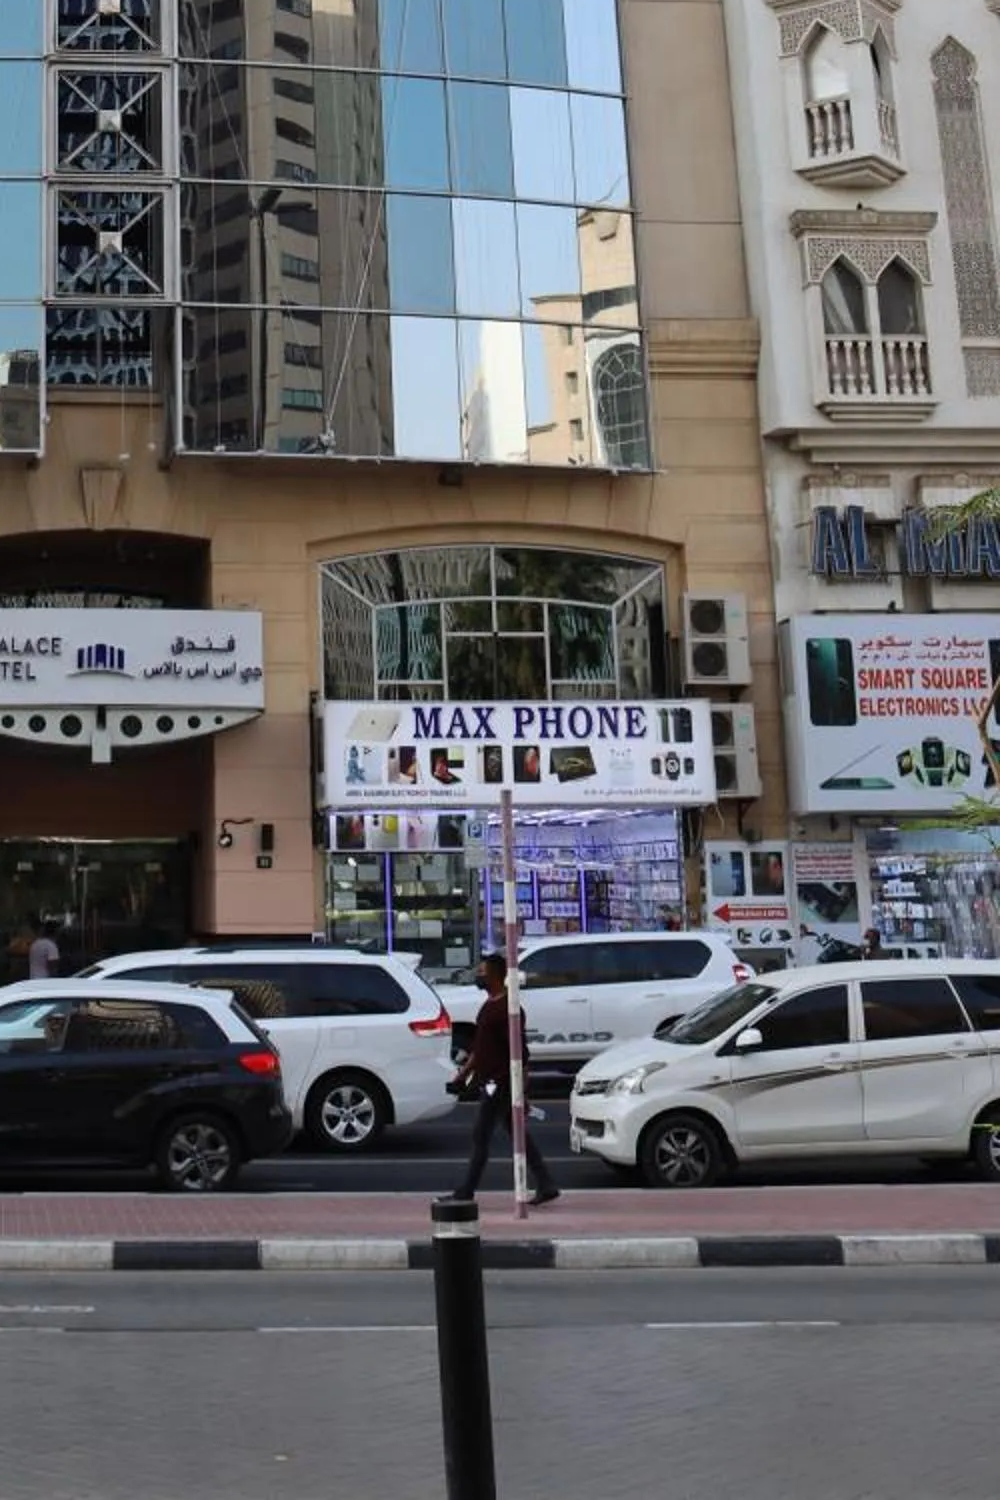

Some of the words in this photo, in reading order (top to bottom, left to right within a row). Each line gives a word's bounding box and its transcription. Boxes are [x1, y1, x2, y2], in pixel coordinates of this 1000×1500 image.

[813, 505, 886, 577] AL
[170, 633, 236, 656] فندق
[858, 667, 915, 690] SMART
[920, 667, 988, 690] SQUARE
[859, 697, 960, 717] ELECTRONICS
[412, 705, 497, 740] MAX
[512, 705, 648, 740] PHONE
